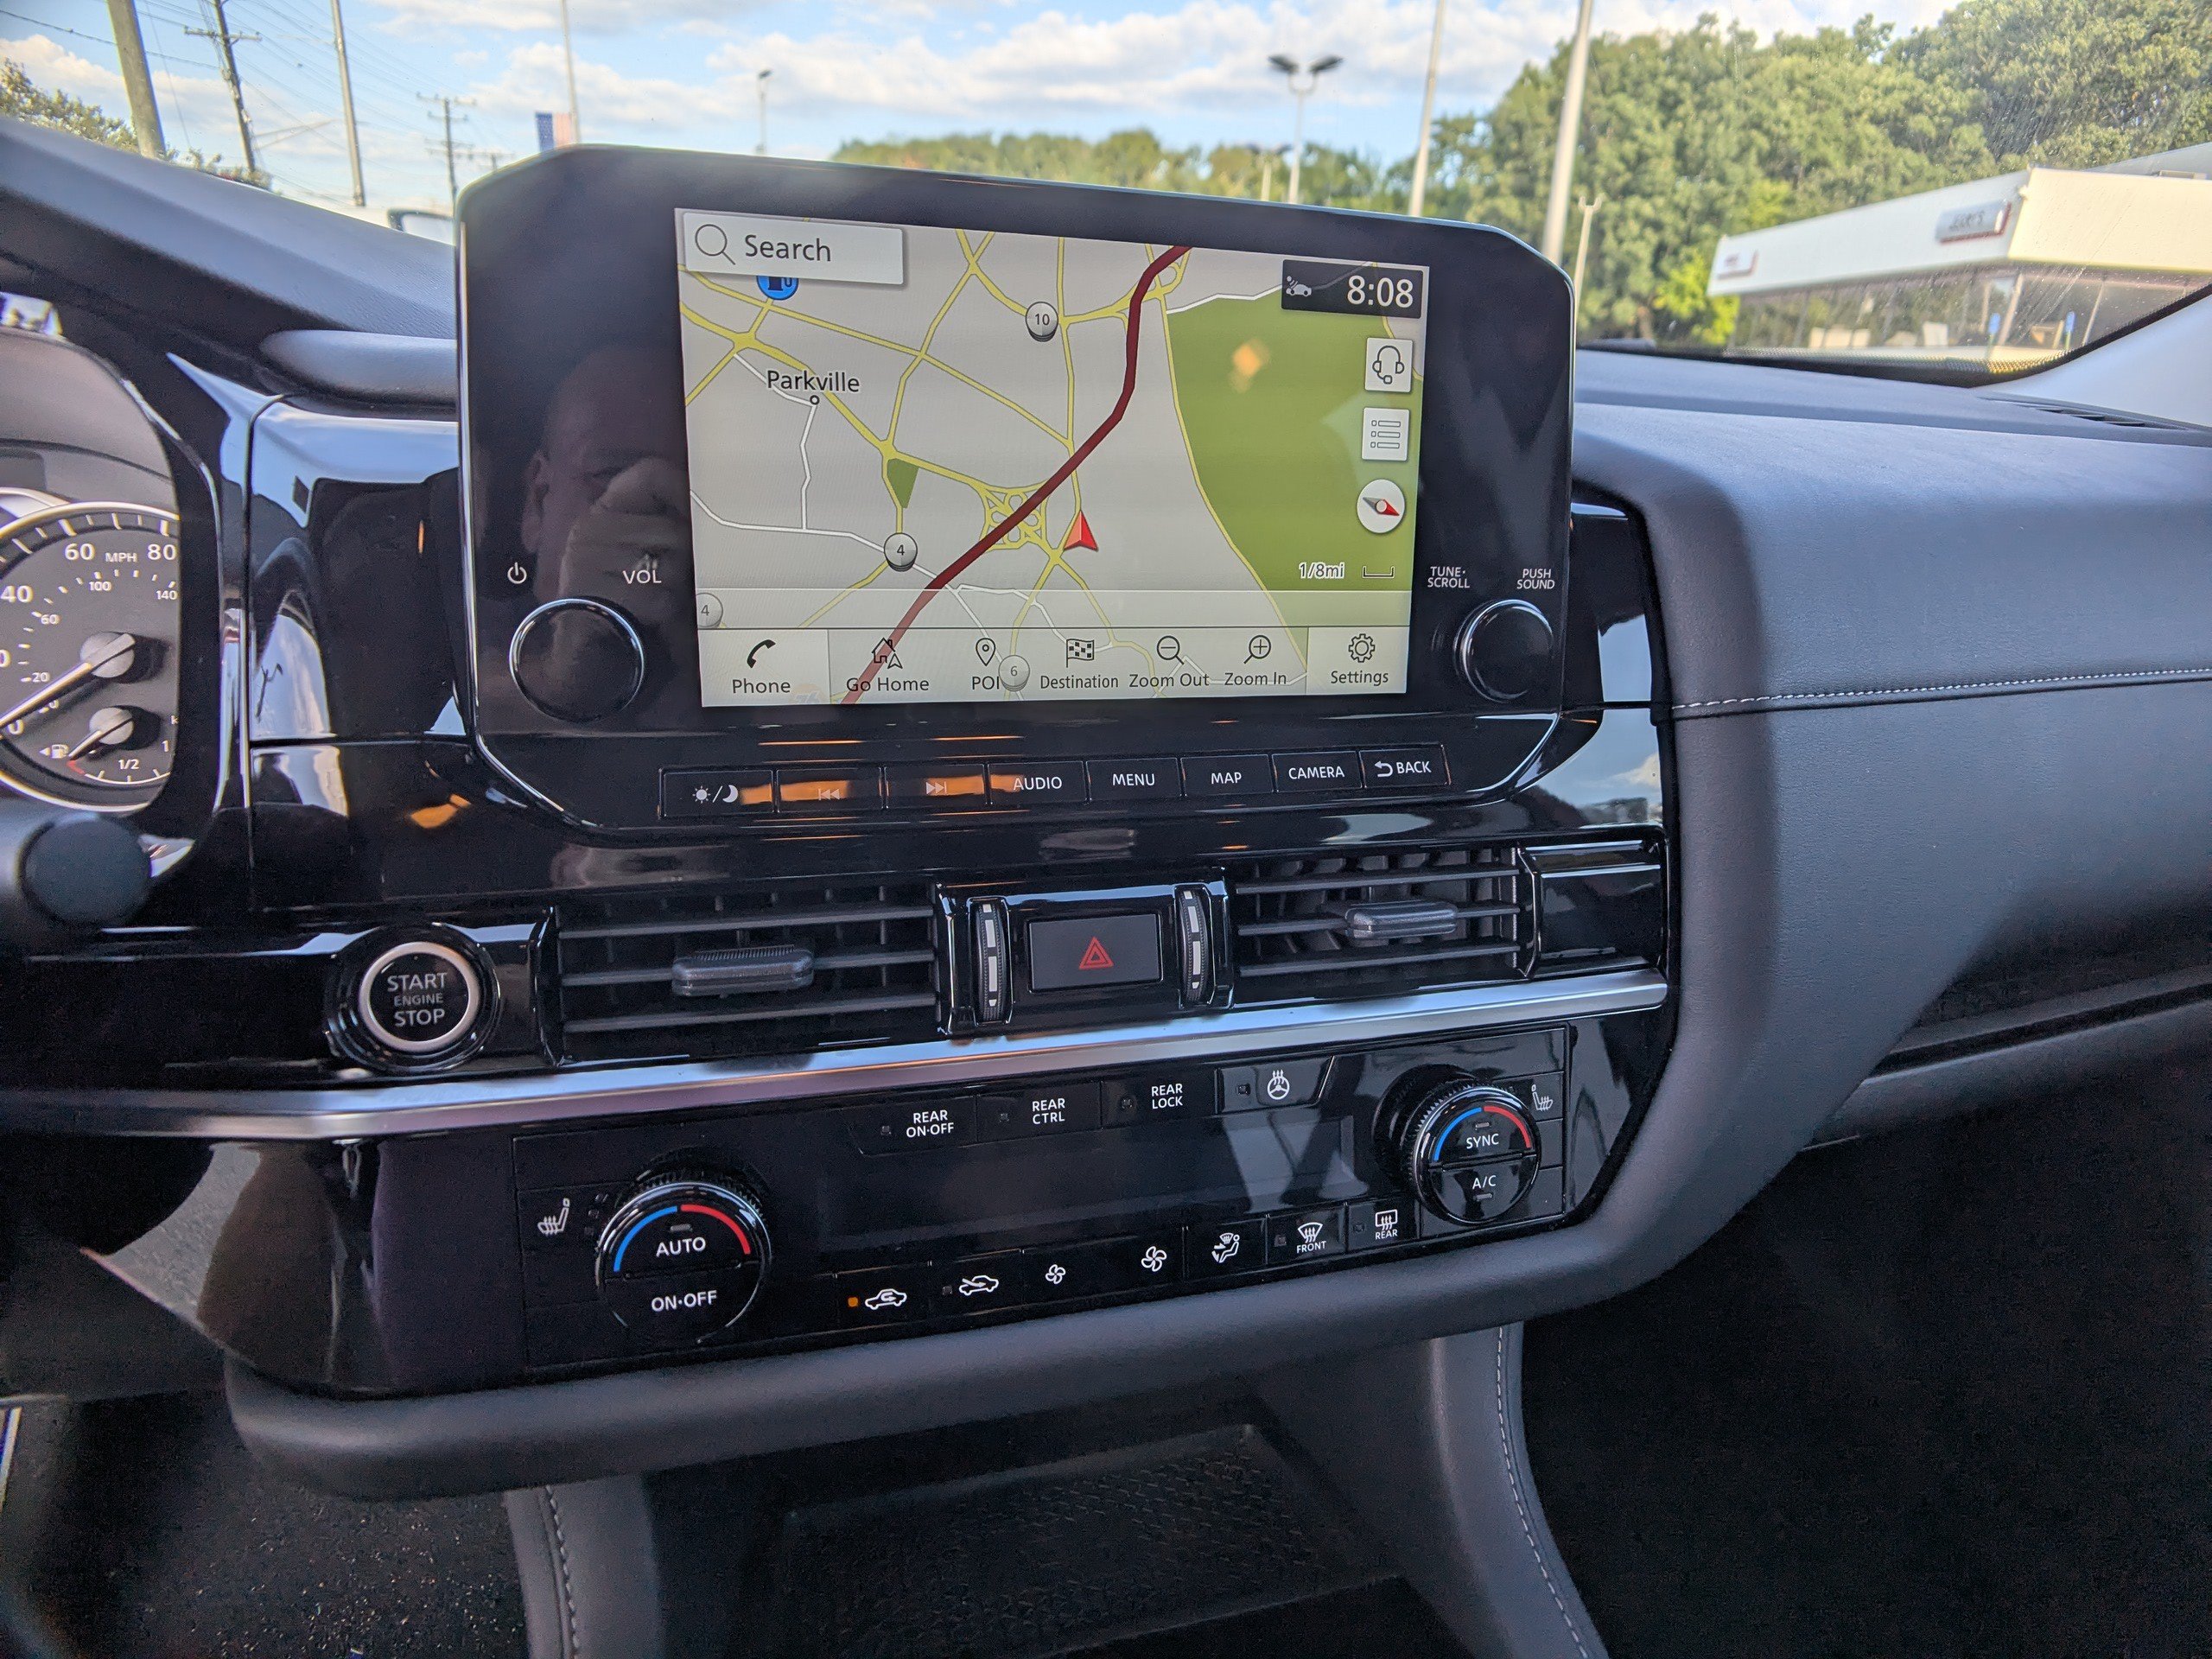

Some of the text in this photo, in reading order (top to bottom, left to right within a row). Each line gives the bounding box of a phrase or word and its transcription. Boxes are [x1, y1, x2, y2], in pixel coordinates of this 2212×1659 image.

[745, 234, 831, 262] Search
[1346, 275, 1414, 308] 8:08
[1035, 313, 1050, 326] 10
[767, 371, 860, 392] Parkville
[65, 543, 94, 560] 60
[147, 543, 175, 560] 80
[897, 543, 905, 556] 4
[105, 552, 137, 563] MPH
[623, 570, 662, 584] VOL
[1299, 563, 1344, 578] 1/8mi
[1522, 569, 1551, 578] PUSH
[89, 580, 111, 592] 100
[1427, 577, 1470, 588] SCROLL
[1516, 580, 1554, 589] SOUND
[1, 585, 33, 602] 40
[156, 590, 177, 600] 140
[701, 605, 709, 616] 4
[41, 613, 59, 625] 60
[0, 650, 10, 667] 0
[32, 672, 49, 683] 20
[1010, 665, 1018, 677] 6
[846, 677, 929, 692] Go Home
[972, 677, 1000, 690] POI
[1040, 674, 1119, 689] Destination
[1129, 674, 1209, 687] Zoom Out
[1224, 671, 1287, 685] Zoom In
[1331, 671, 1389, 685] Settings
[732, 678, 791, 694] Phone
[162, 741, 168, 752] 1
[118, 760, 139, 770] 1/2
[1396, 760, 1431, 774] BACK
[1211, 772, 1242, 785] MAP
[1288, 766, 1344, 779] CAMERA
[1014, 777, 1063, 791] AUDIO
[1112, 774, 1155, 786] MENU
[388, 973, 447, 991] START
[394, 993, 443, 1007] ENGINE
[394, 1008, 445, 1027] STOP
[1151, 1084, 1183, 1096] REAR
[1032, 1098, 1065, 1110] REAR
[1152, 1096, 1183, 1109] LOCK
[912, 1109, 948, 1123] REAR
[1032, 1112, 1065, 1125] CTRL
[1466, 1134, 1499, 1149] SYNC
[1472, 1175, 1497, 1189] A/C
[1375, 1229, 1398, 1240] REAR
[656, 1236, 706, 1256] AUTO
[1297, 1241, 1326, 1253] FRONT
